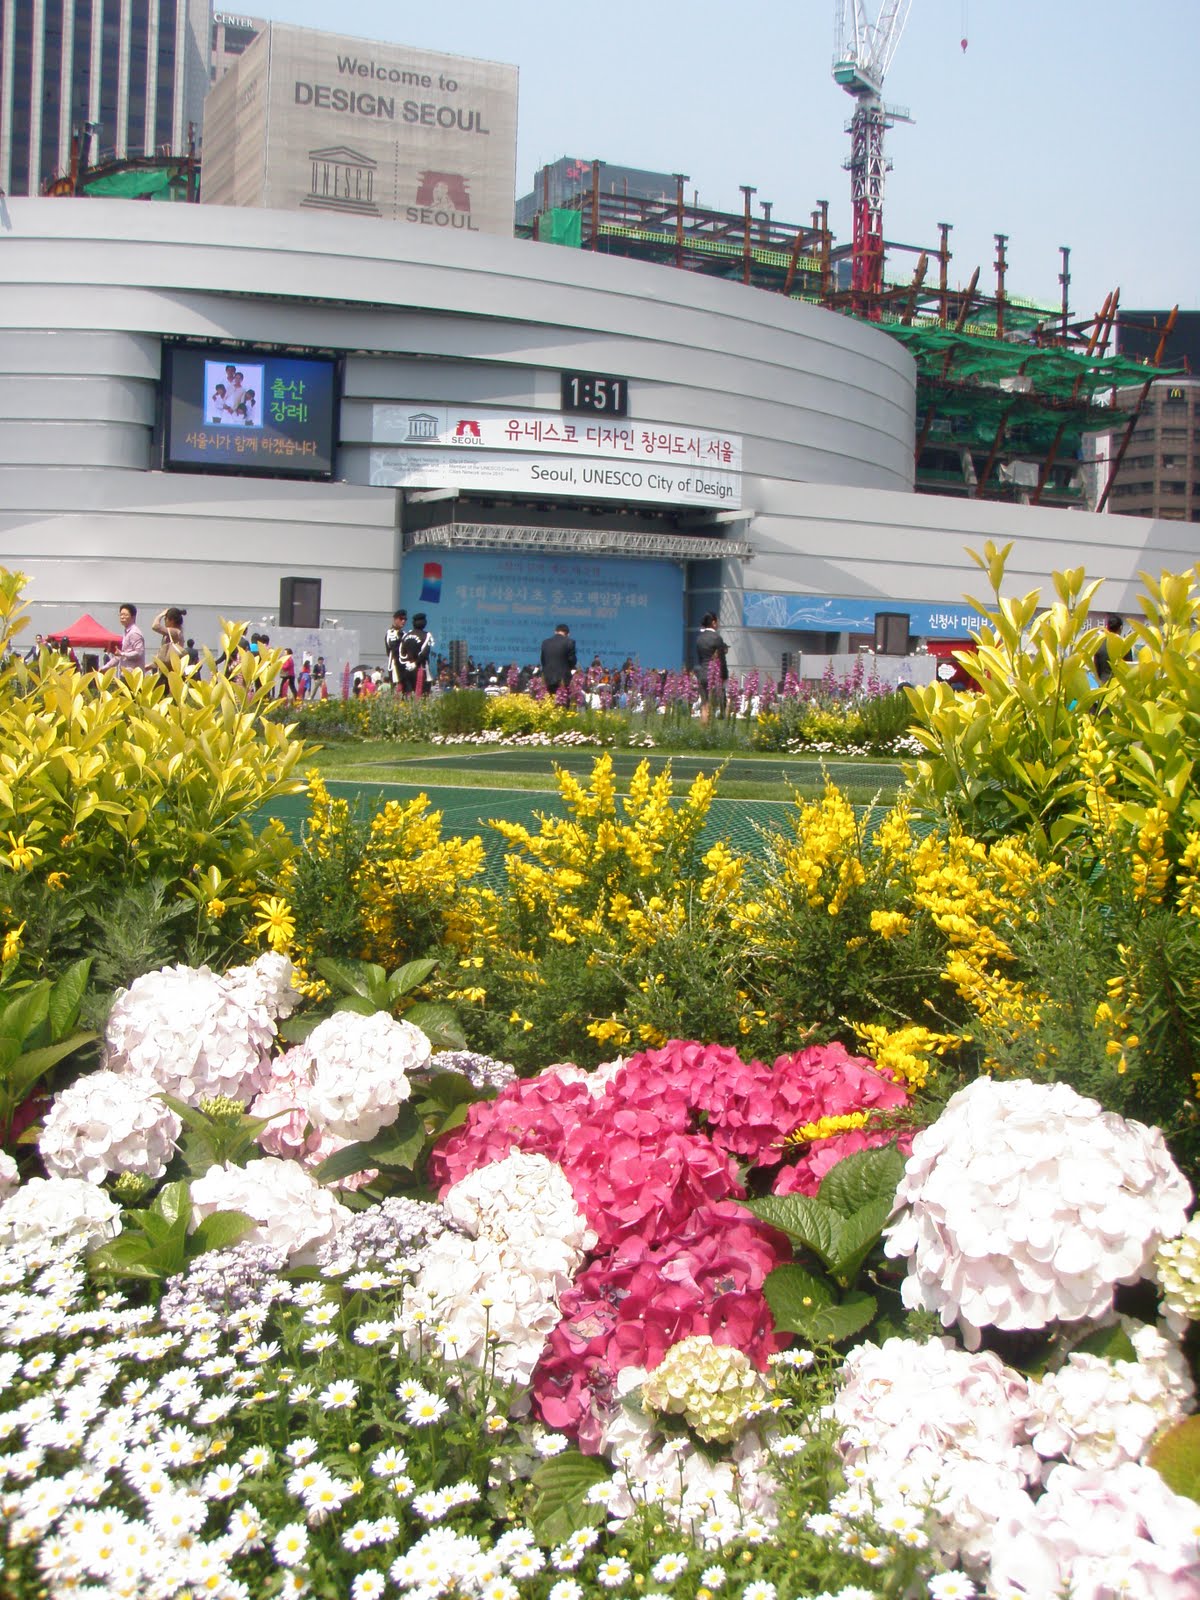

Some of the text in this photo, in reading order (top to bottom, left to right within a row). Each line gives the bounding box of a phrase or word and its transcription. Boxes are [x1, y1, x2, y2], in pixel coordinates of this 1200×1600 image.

[214, 13, 252, 28] CENTER
[337, 56, 458, 92] Welcome to
[295, 81, 394, 120] DESIGN
[402, 100, 490, 135] SEOUL
[312, 161, 373, 202] UNESCO
[406, 207, 480, 232] SEOUL
[270, 378, 305, 400] 출산
[571, 378, 620, 410] 1:51
[270, 402, 308, 422] 장려!
[186, 432, 316, 456] 서울시가 함께 하겠습니다
[452, 436, 485, 446] SEOUL
[504, 420, 578, 443] 유네스코
[586, 426, 634, 451] 디자인
[532, 466, 733, 498] Seoul, UNESCO City of Design
[928, 614, 958, 629] 신청사
